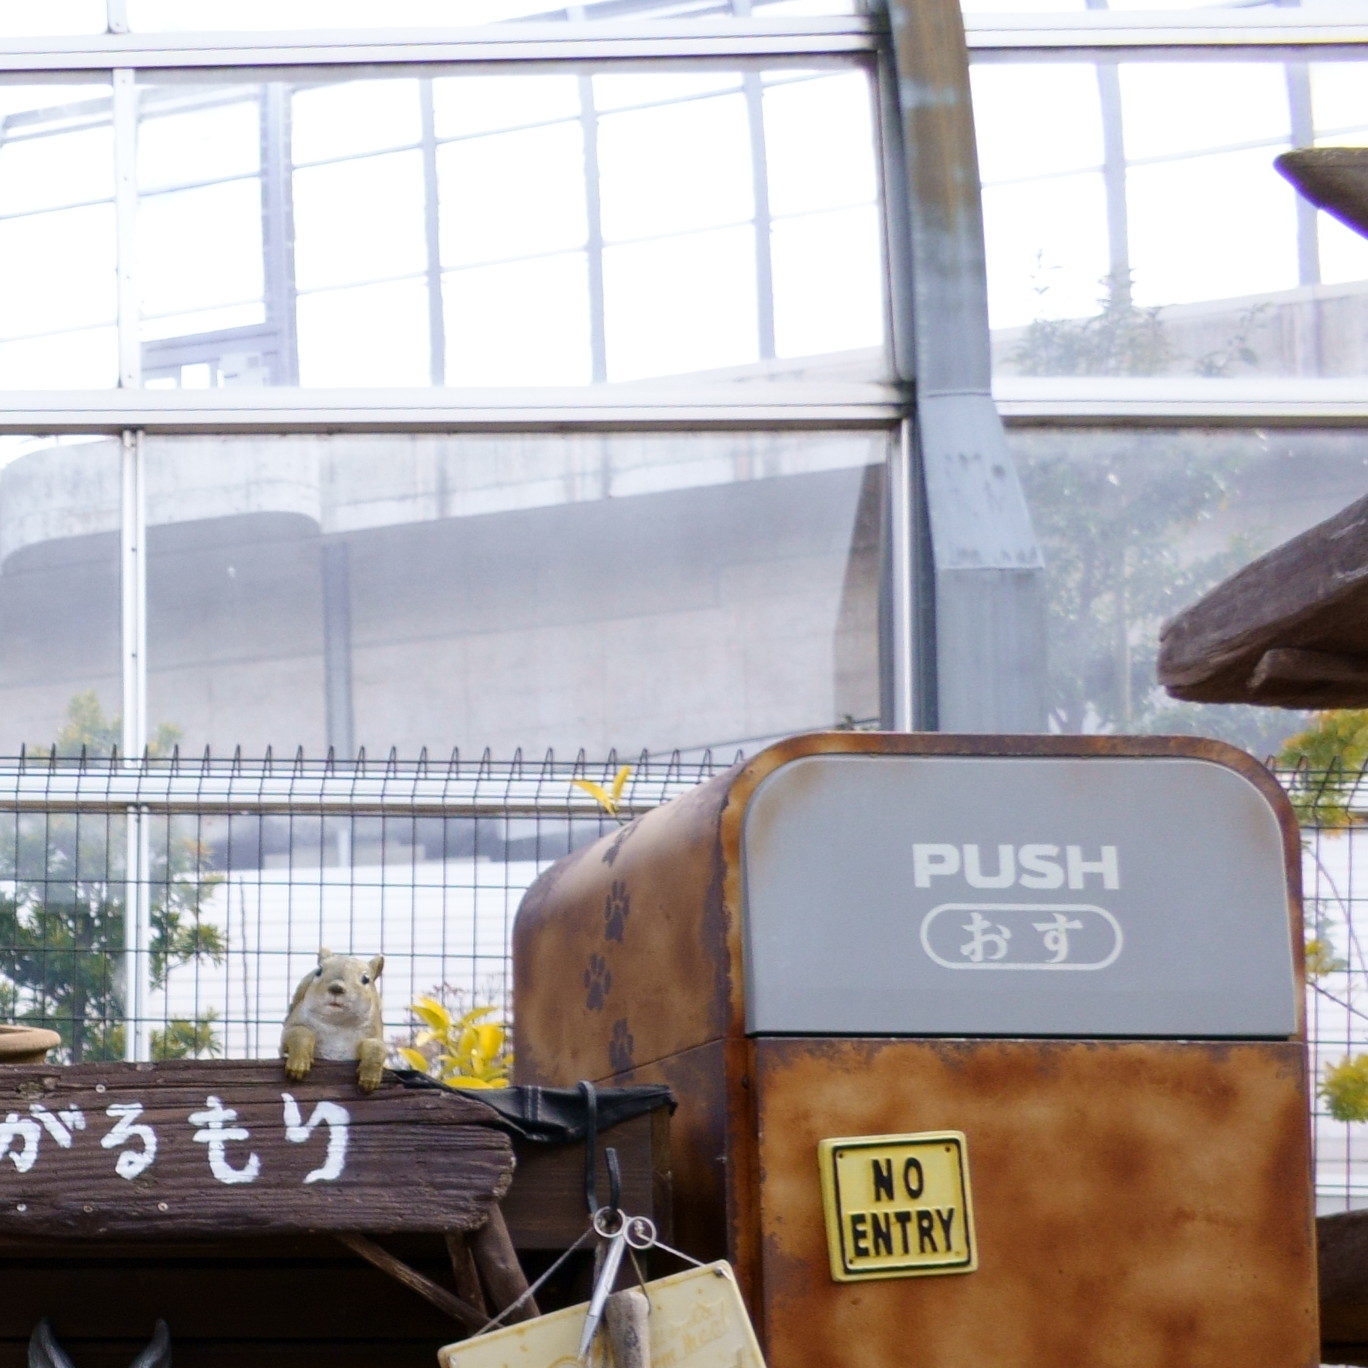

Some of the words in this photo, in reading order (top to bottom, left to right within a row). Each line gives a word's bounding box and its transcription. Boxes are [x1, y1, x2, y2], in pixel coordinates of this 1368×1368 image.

[912, 843, 1121, 890] PUSH
[959, 912, 1085, 964] おす
[871, 1157, 926, 1204] NO
[849, 1206, 956, 1260] ENTRY
